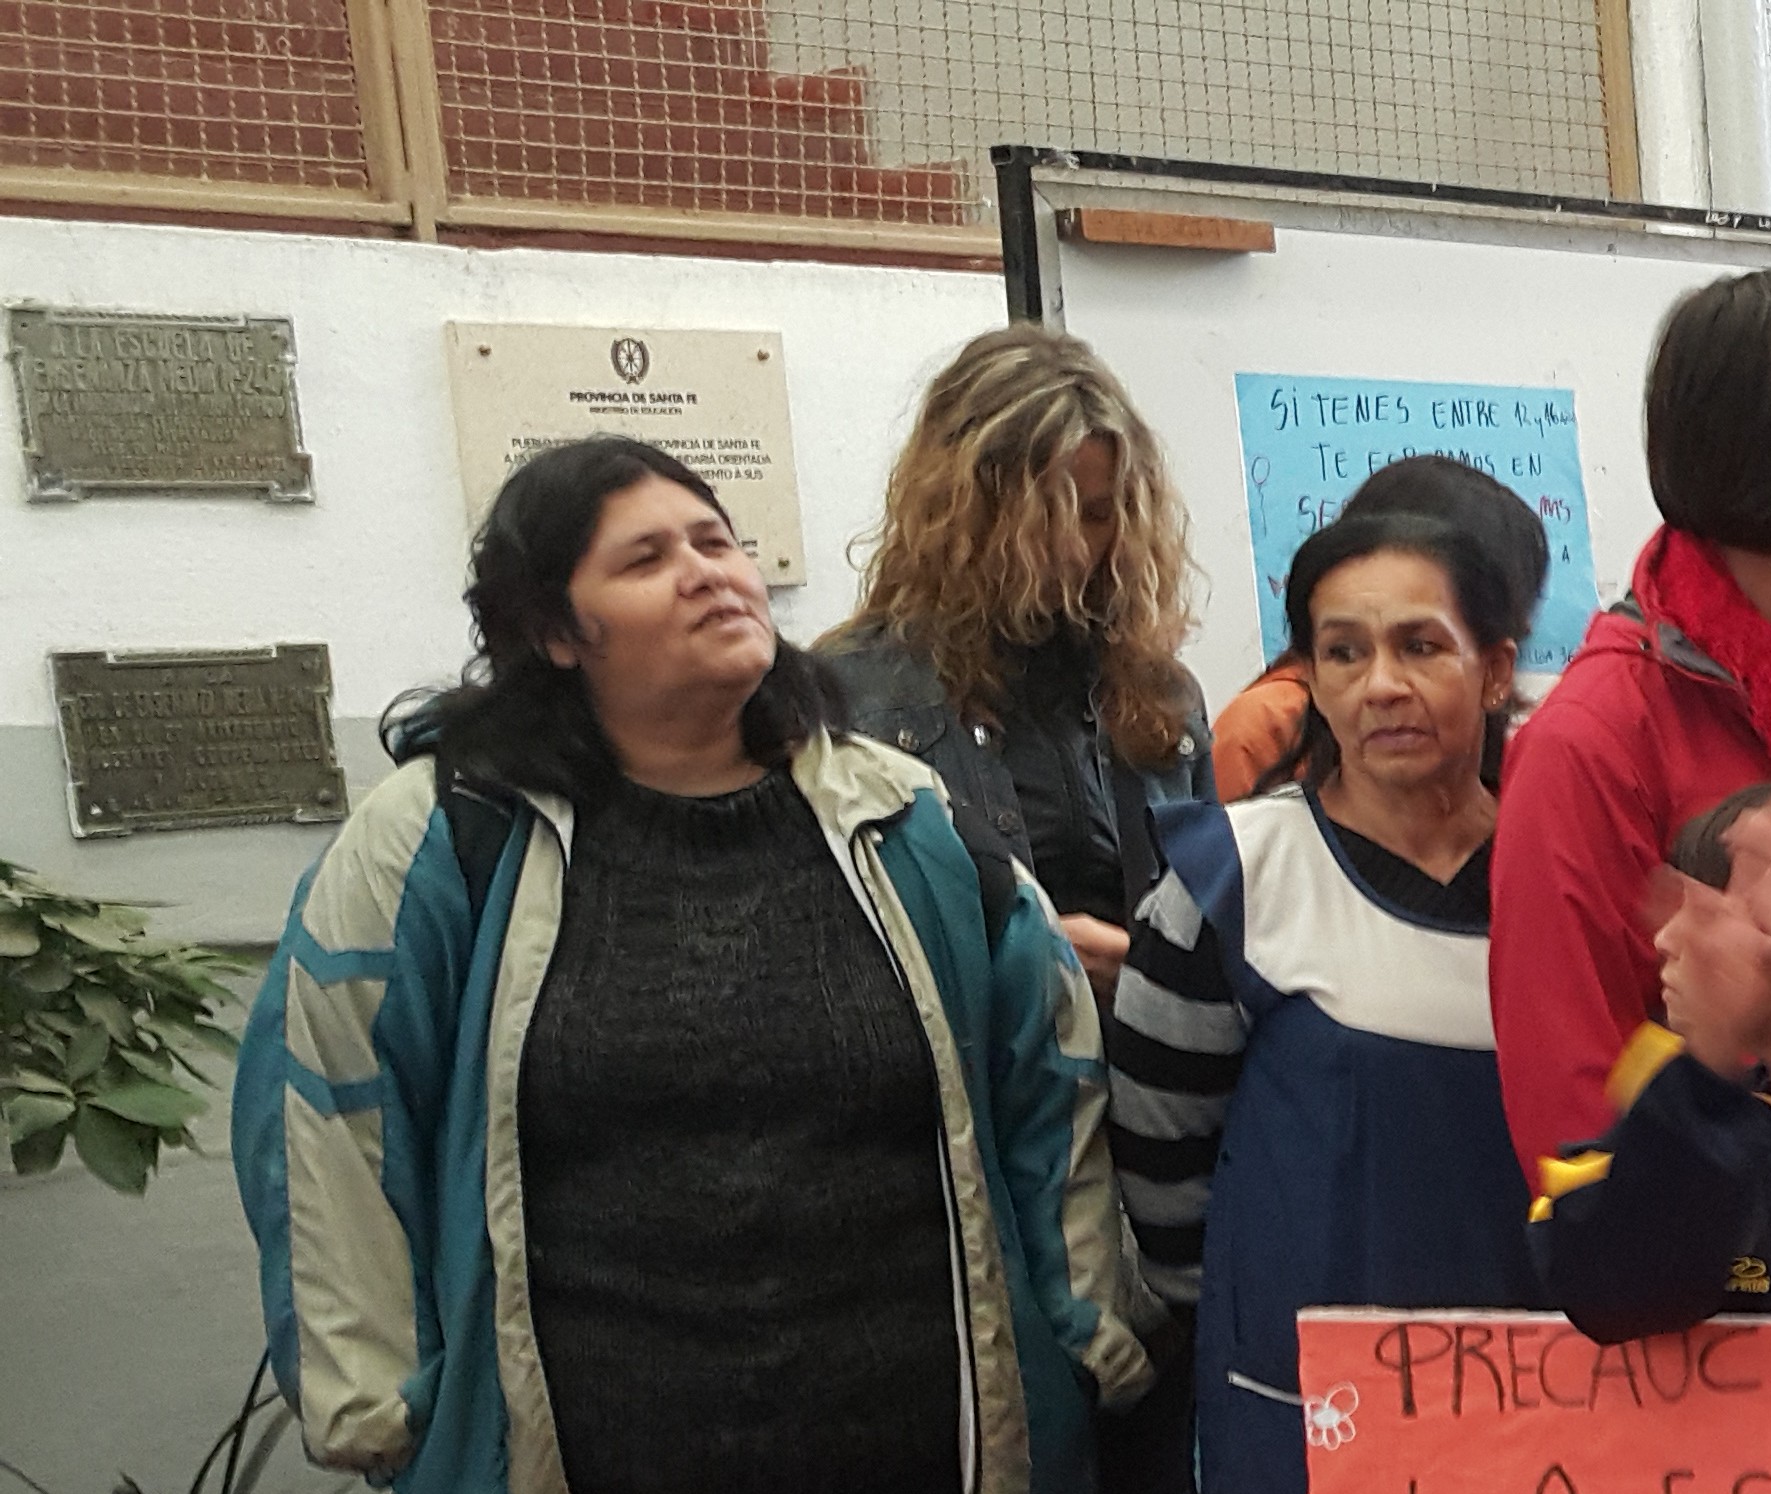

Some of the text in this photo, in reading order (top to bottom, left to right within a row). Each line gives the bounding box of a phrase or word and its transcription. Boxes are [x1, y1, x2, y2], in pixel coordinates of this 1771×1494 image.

[569, 391, 631, 402] PROVINCIA
[649, 392, 684, 404] SANTA
[1432, 400, 1500, 430] ENTRE
[1312, 443, 1348, 481] TE
[1512, 453, 1542, 477] EN
